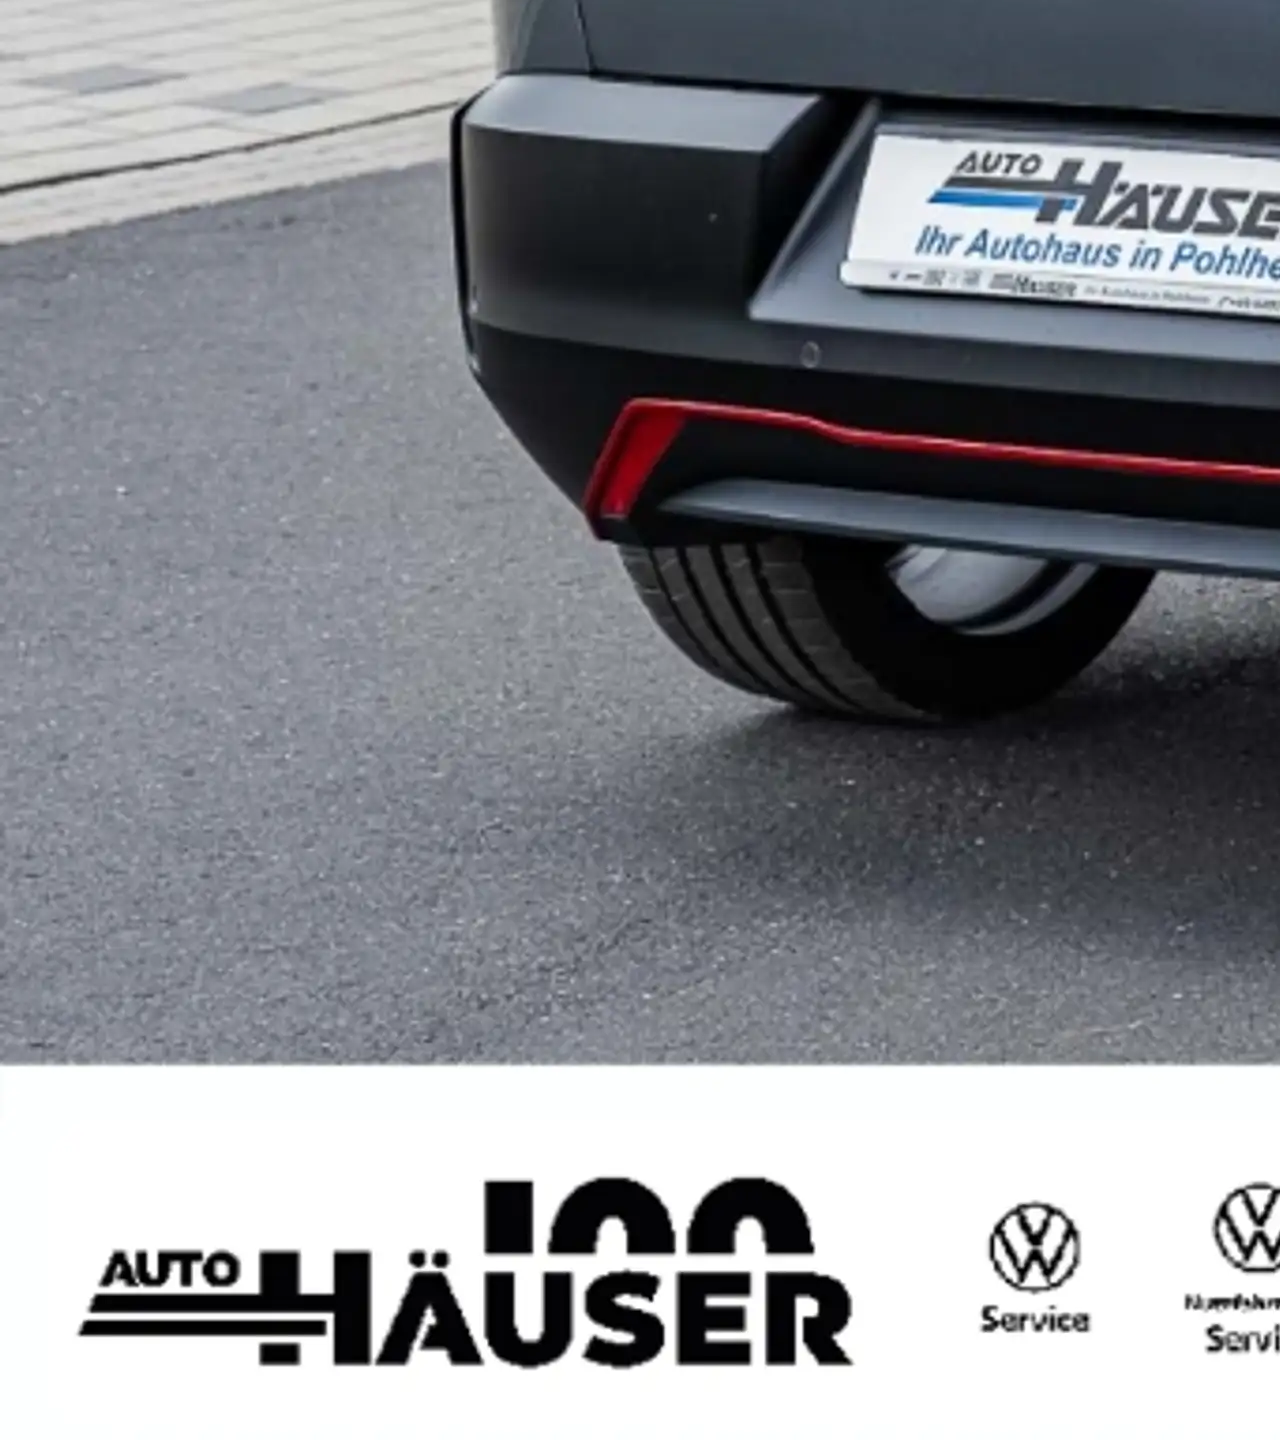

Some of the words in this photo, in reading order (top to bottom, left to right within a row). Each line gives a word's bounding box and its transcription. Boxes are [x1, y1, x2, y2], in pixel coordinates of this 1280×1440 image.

[955, 151, 1044, 175] AUTO
[914, 224, 961, 257] Ihr
[964, 227, 1121, 269] Autohaus
[1129, 239, 1164, 270] in
